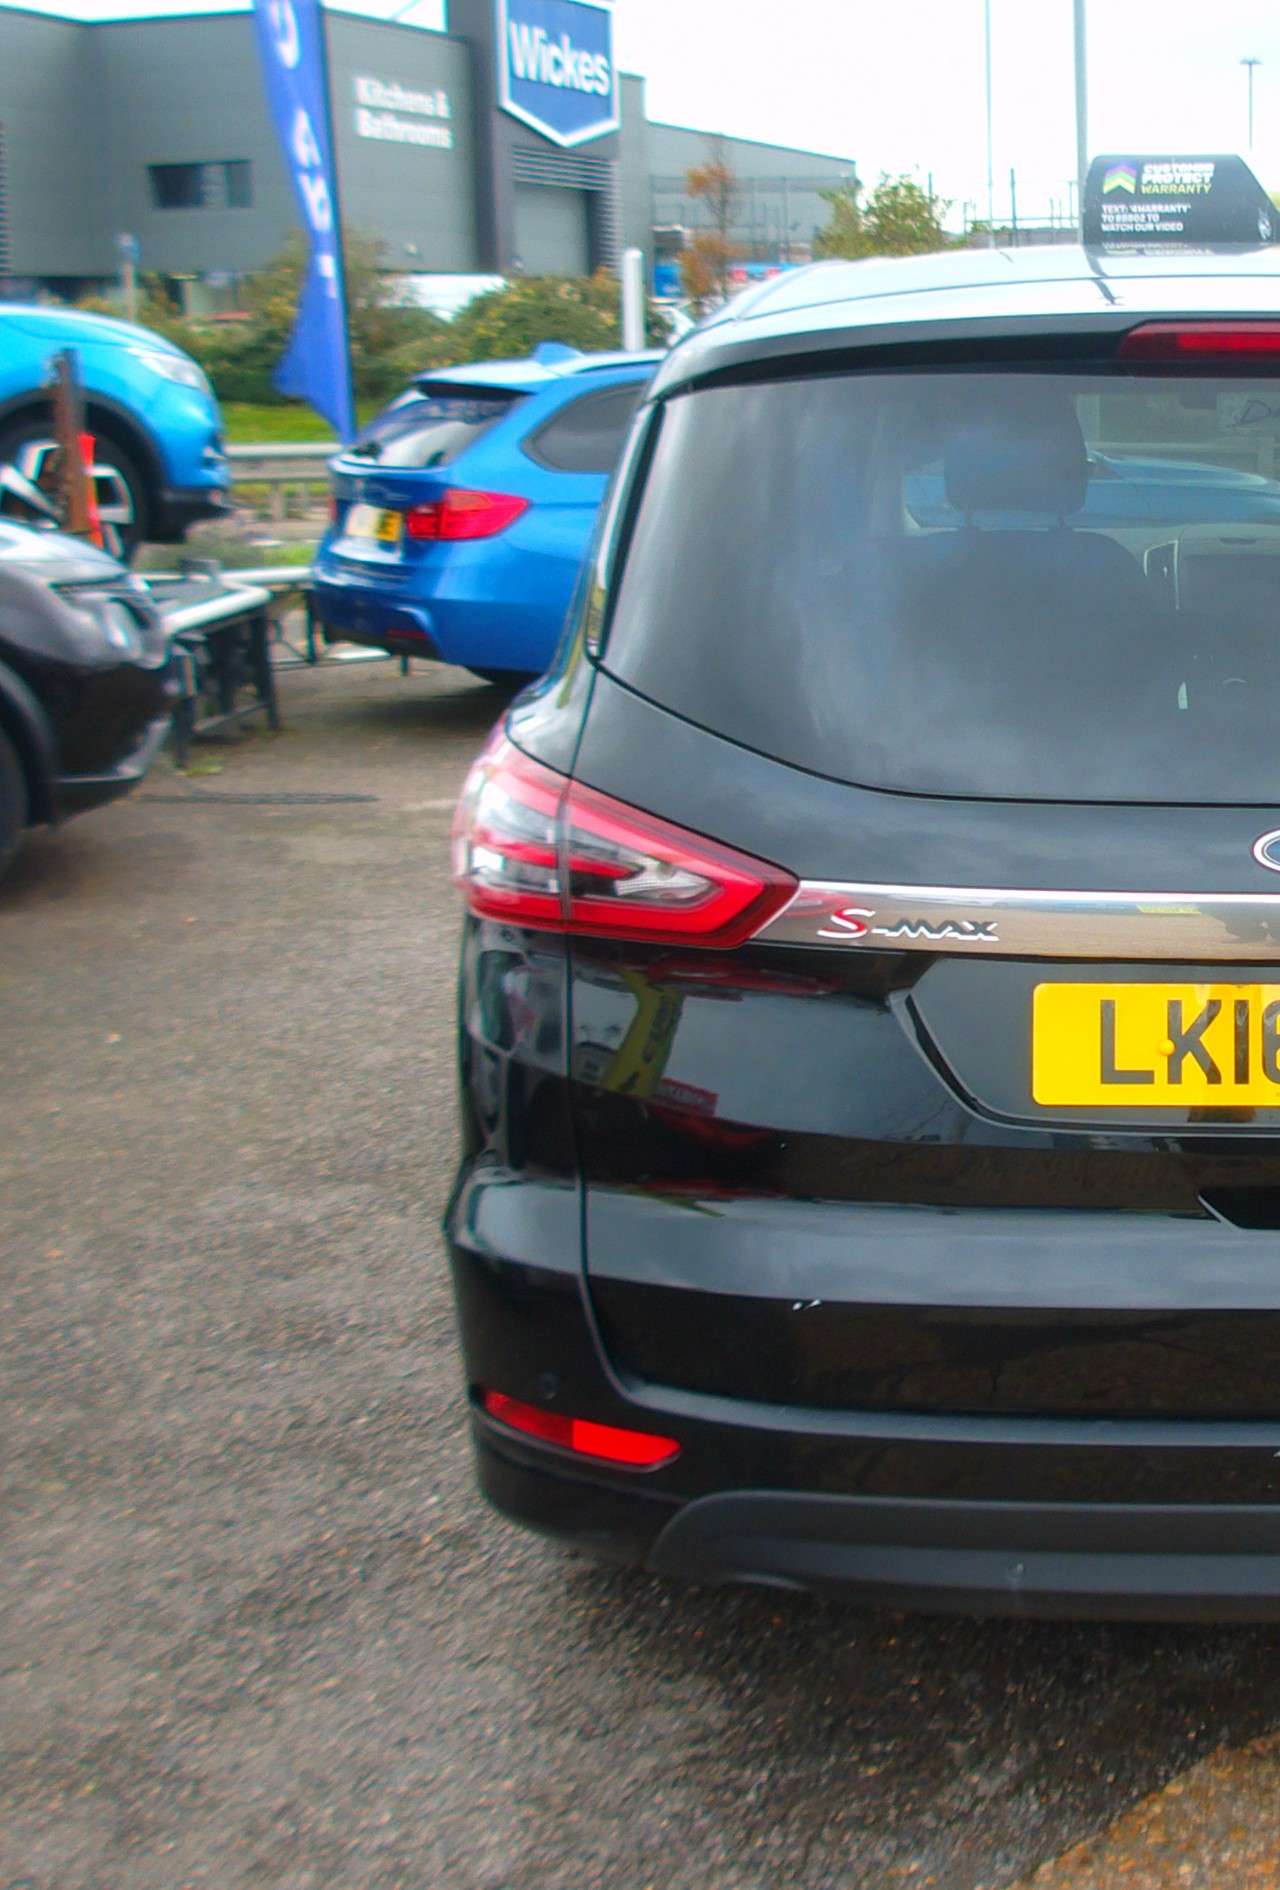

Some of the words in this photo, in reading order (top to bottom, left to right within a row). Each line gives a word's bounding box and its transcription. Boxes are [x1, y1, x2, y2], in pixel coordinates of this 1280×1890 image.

[509, 20, 610, 97] Wickes
[1141, 183, 1213, 194] WARRANTY
[1155, 222, 1184, 232] VIDEO
[816, 907, 1000, 942] S-MAX
